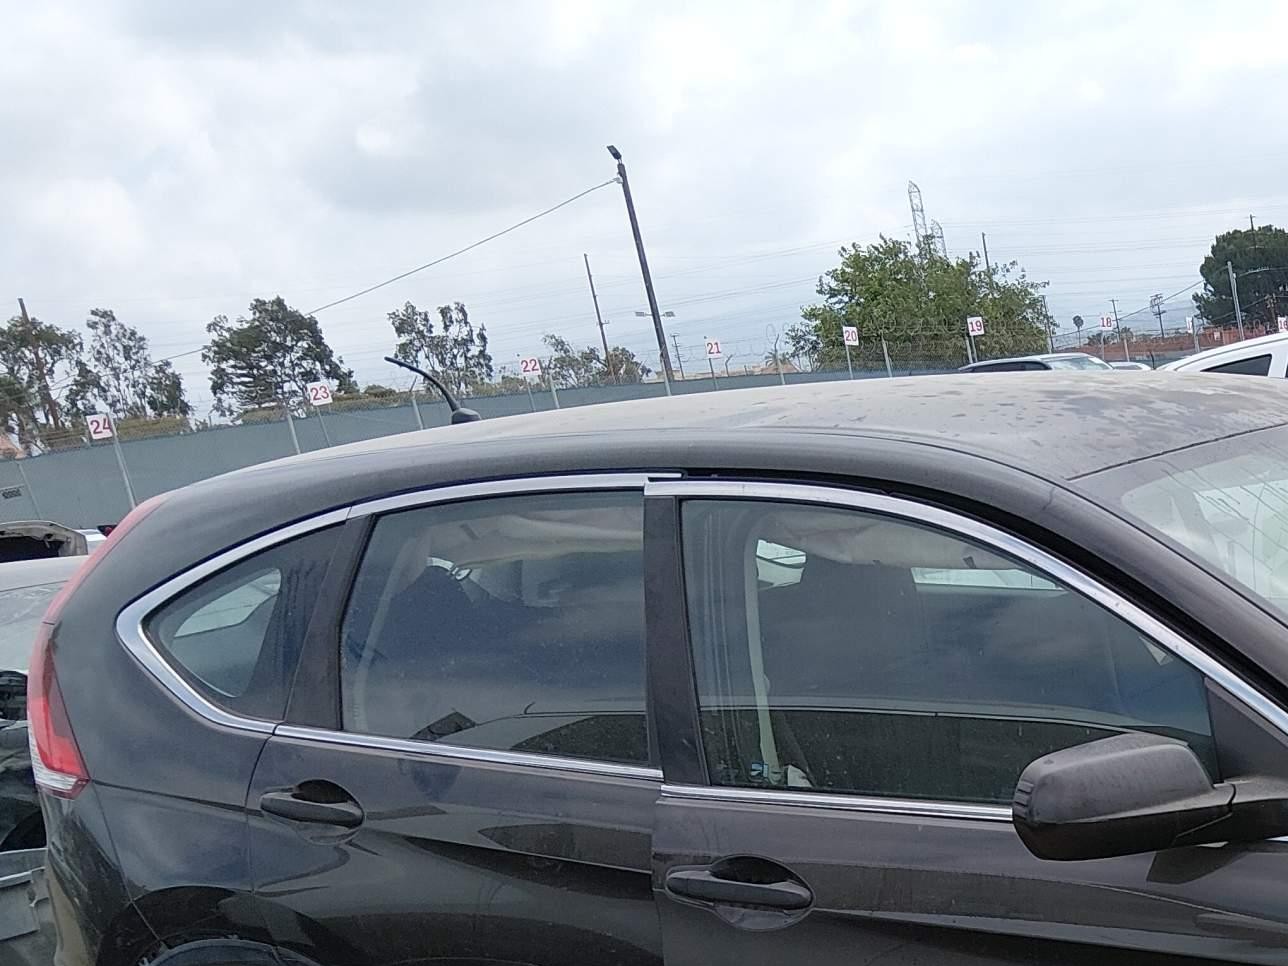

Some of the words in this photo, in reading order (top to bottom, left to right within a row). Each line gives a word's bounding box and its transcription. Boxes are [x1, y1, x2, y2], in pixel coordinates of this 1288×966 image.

[970, 321, 983, 332] 19
[1101, 317, 1112, 328] 18
[845, 330, 857, 342] 20
[707, 342, 722, 354] 21
[521, 359, 539, 373] 22
[310, 386, 329, 401] 23
[90, 419, 112, 434] 24
